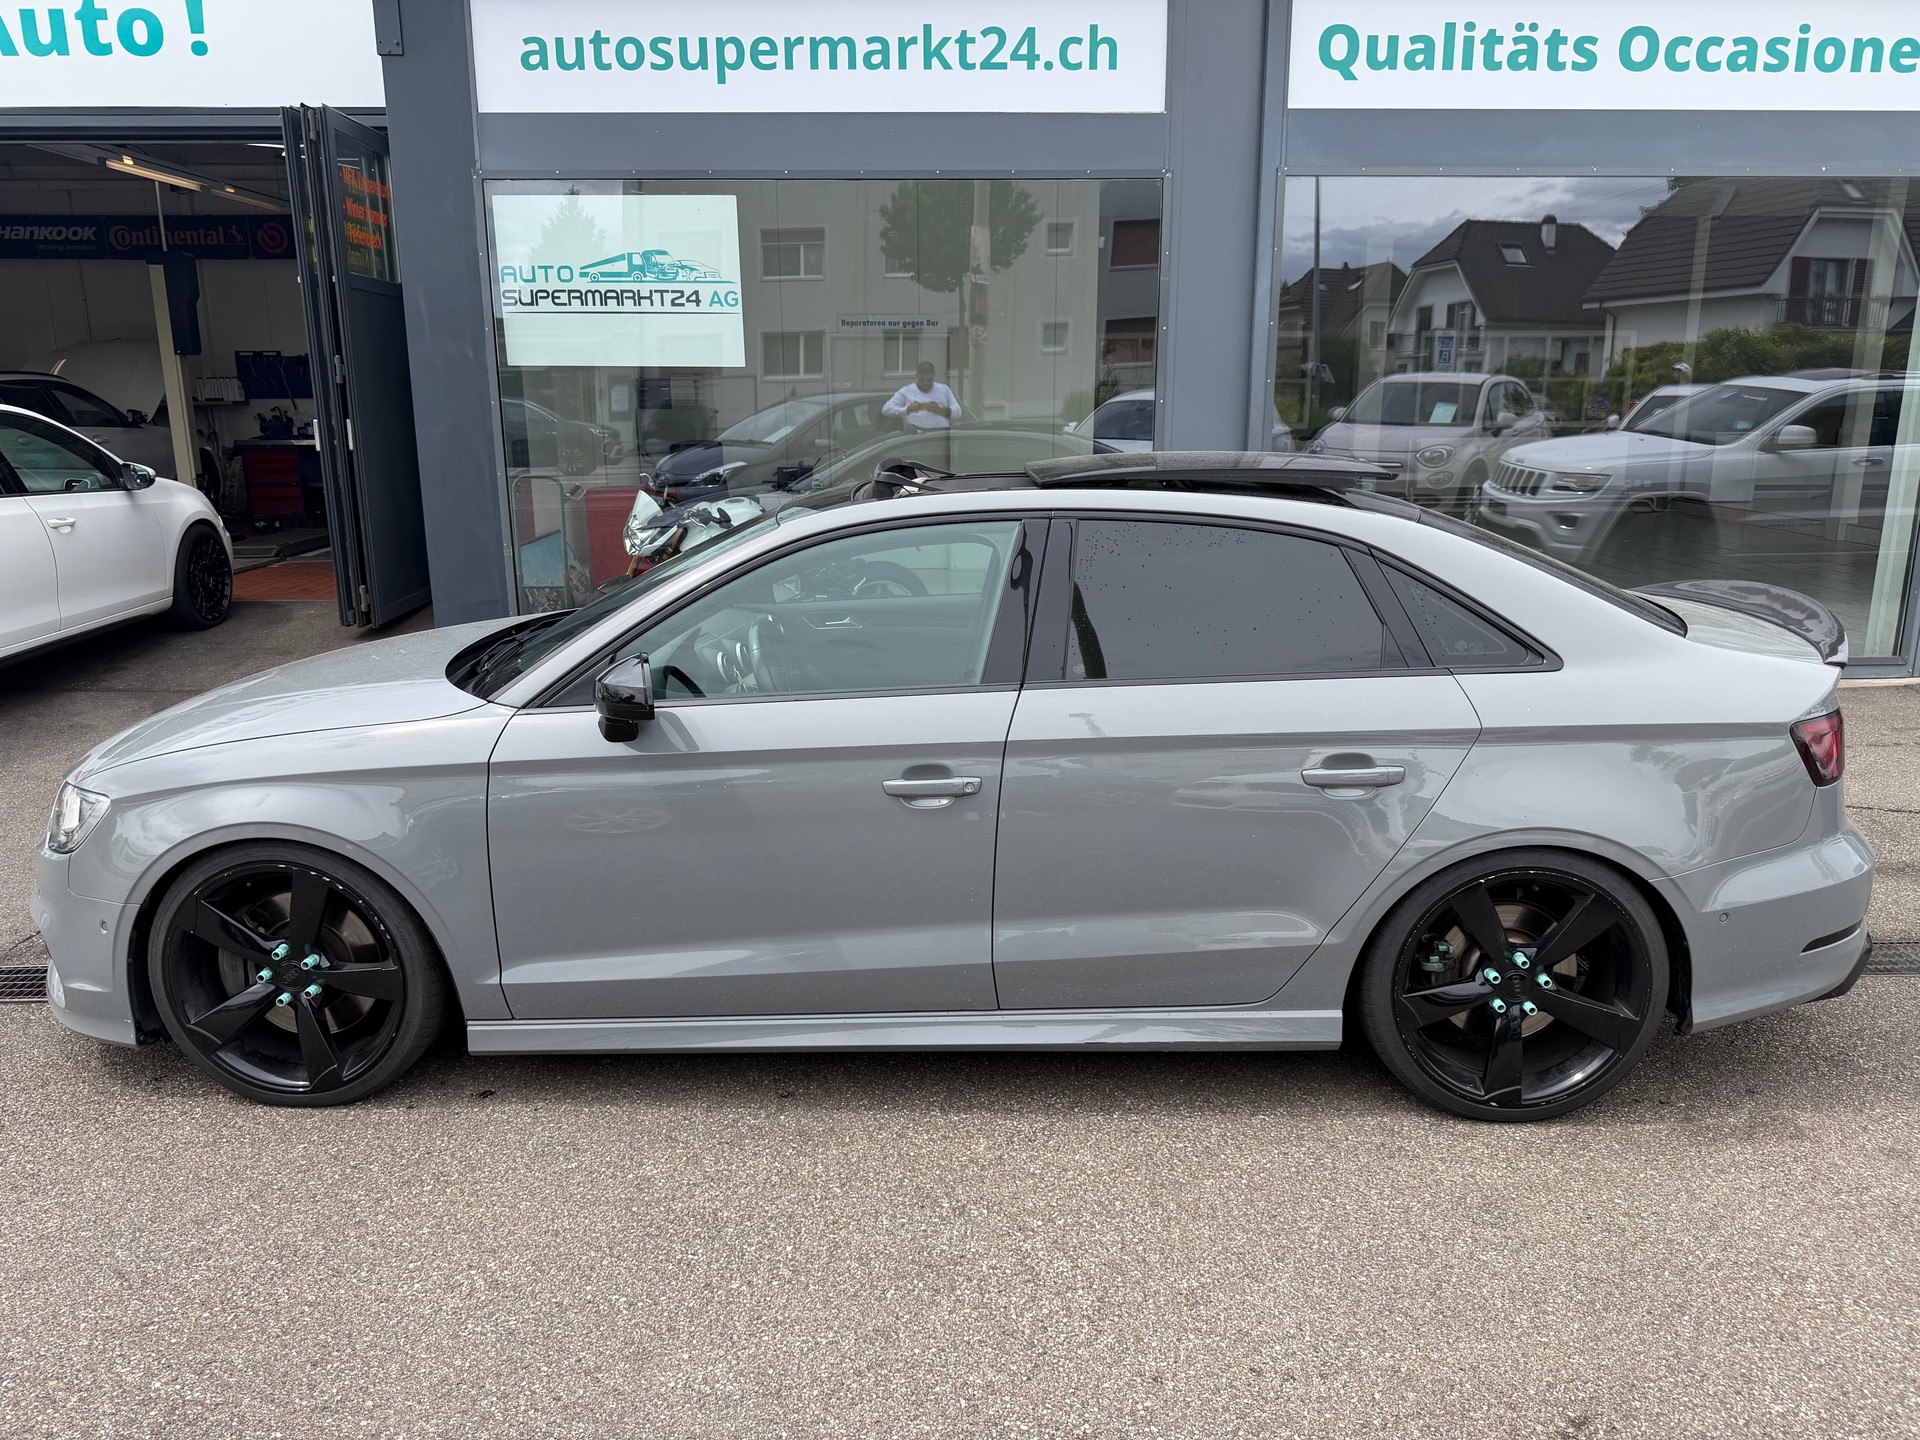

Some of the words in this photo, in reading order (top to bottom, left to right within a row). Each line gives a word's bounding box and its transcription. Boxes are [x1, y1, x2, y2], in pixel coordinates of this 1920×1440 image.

[519, 24, 1118, 85] autosupermarkt24.ch
[1318, 22, 1598, 81] Qualitäts
[1618, 24, 1920, 73] Occasione
[500, 265, 574, 283] AUTO
[502, 289, 702, 307] SUPERMARKT24
[709, 291, 739, 307] AG
[841, 319, 886, 328] Reparaturen
[902, 320, 924, 328] gegen
